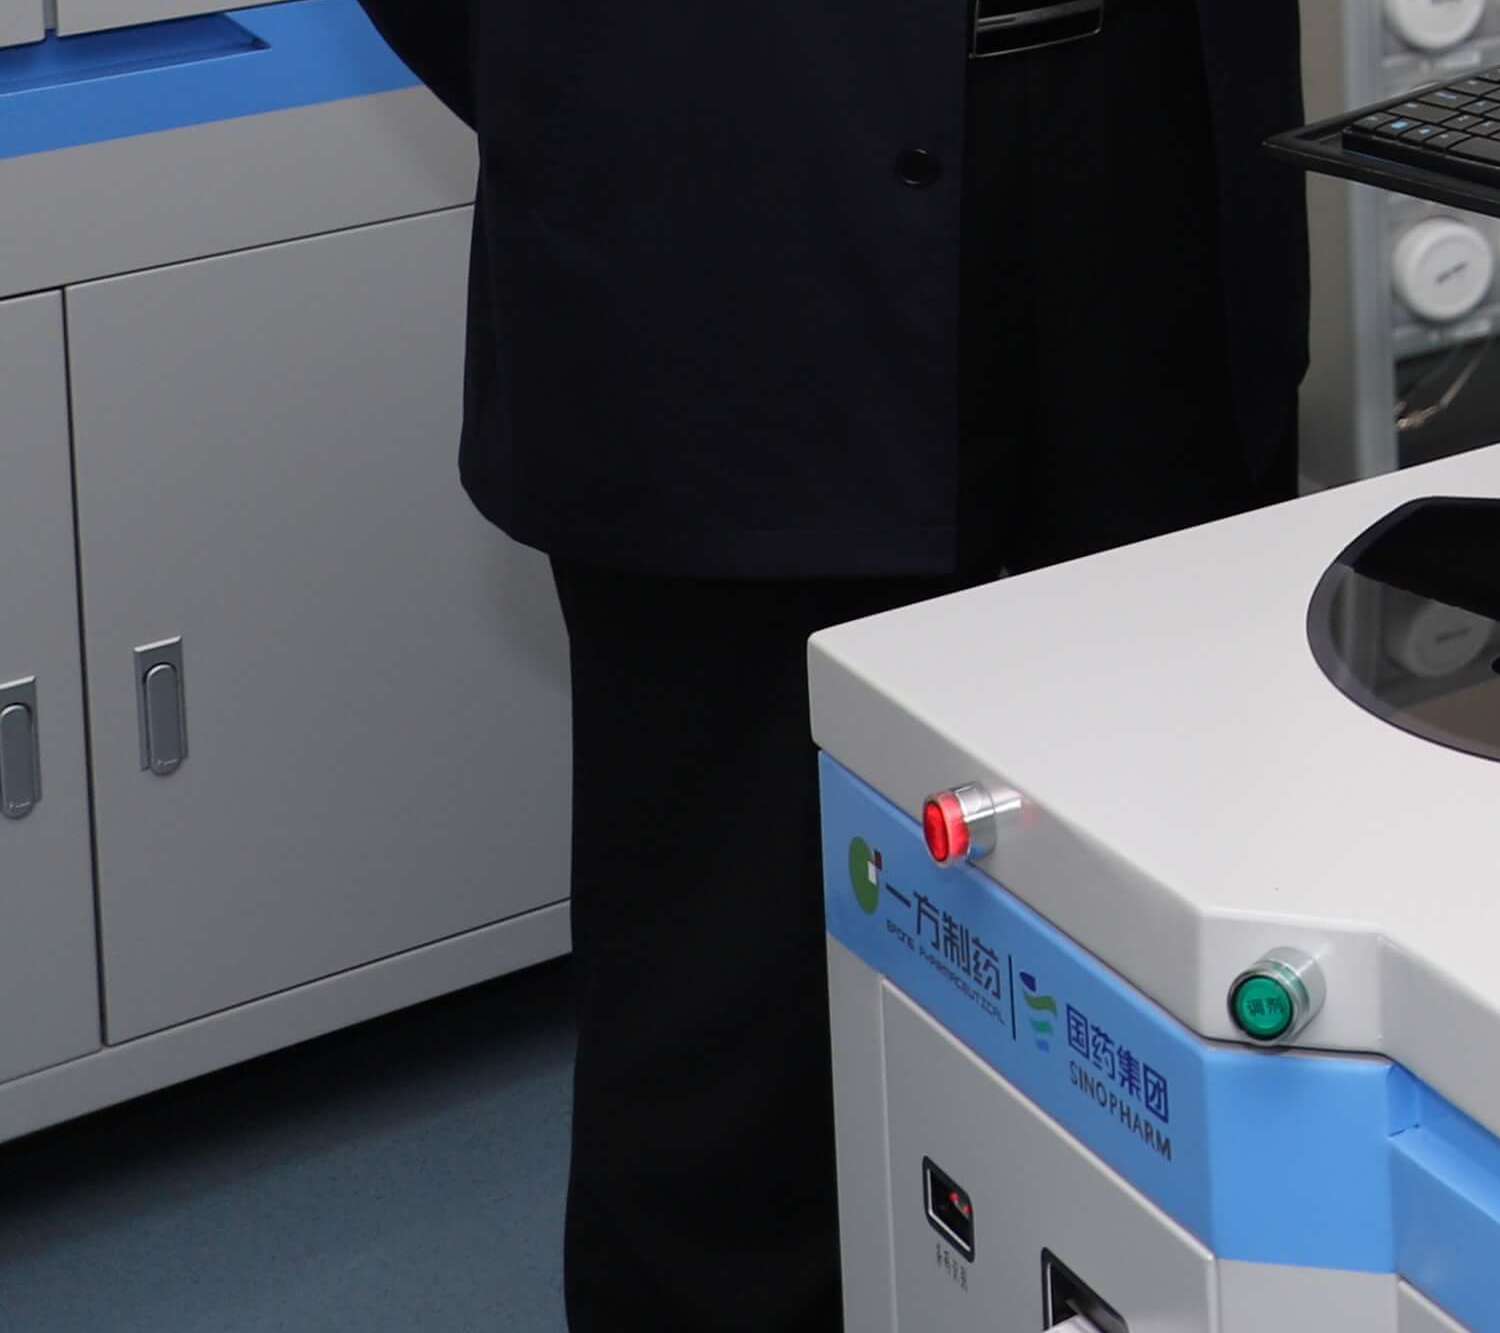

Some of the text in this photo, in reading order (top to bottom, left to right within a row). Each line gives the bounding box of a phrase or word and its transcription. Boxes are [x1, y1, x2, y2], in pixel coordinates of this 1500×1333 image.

[885, 883, 1002, 1000] 一方制药
[1065, 1002, 1169, 1124] 国药集团
[1069, 1060, 1172, 1162] SINOPHARM
